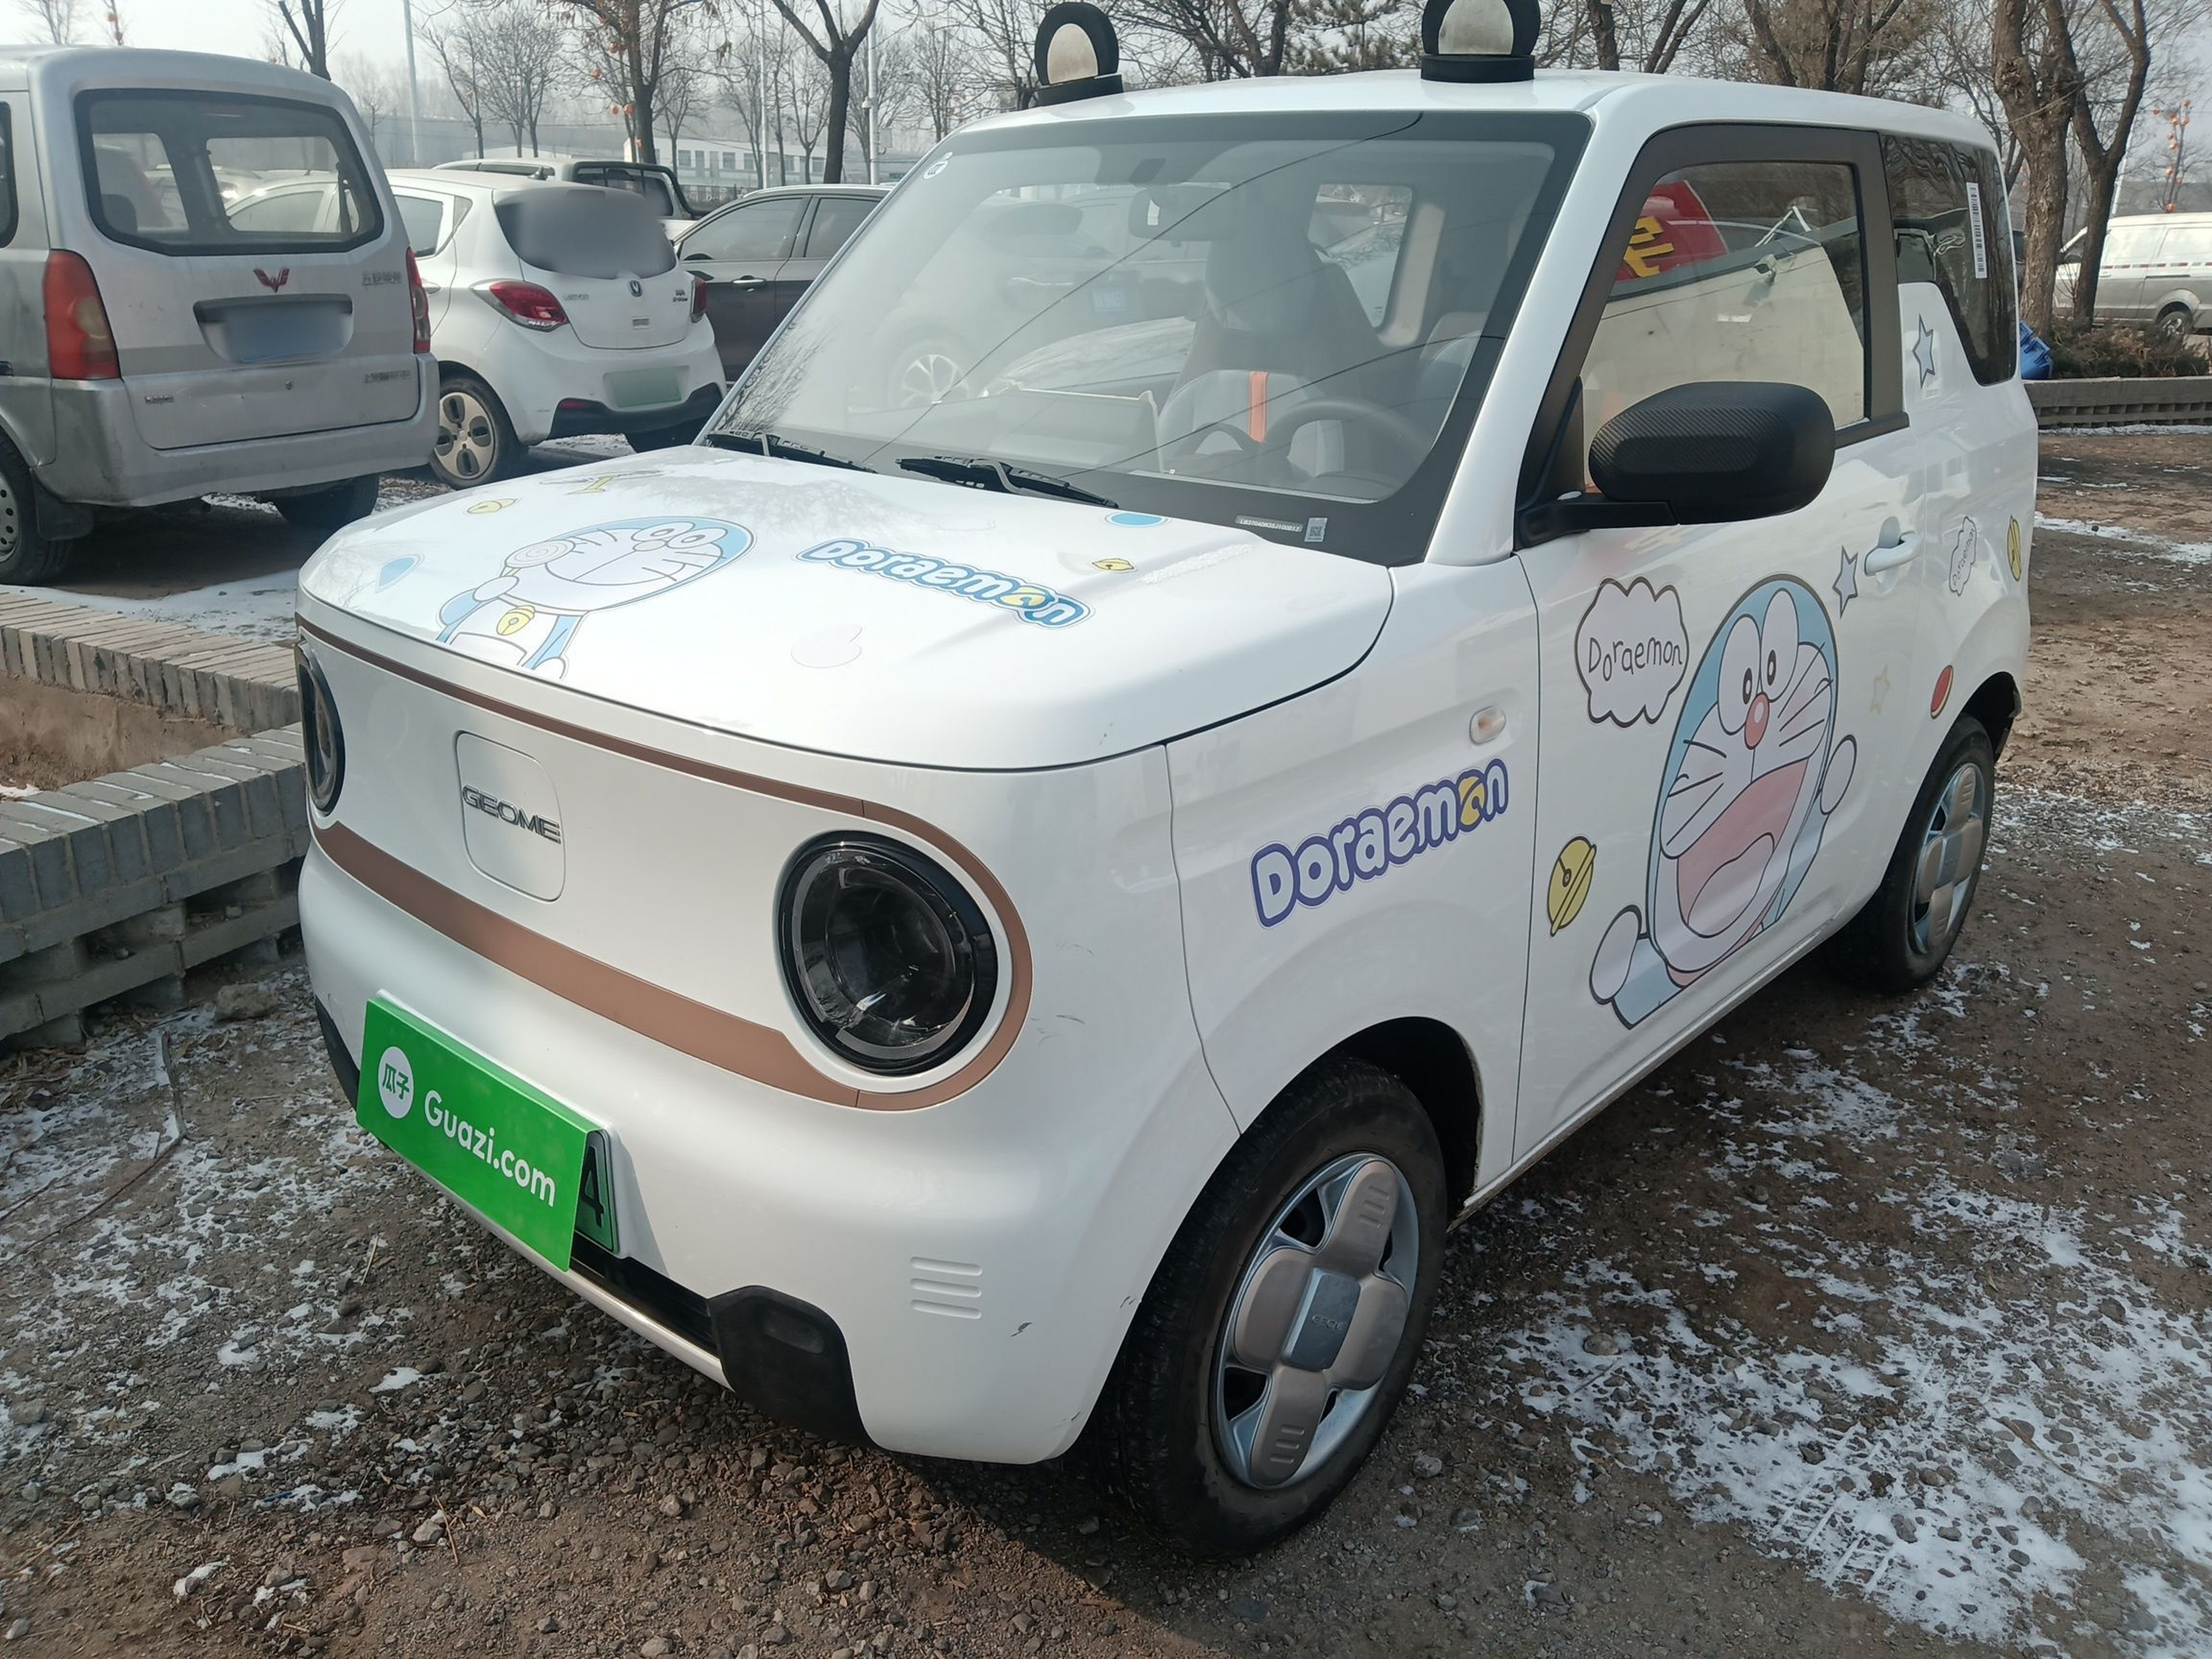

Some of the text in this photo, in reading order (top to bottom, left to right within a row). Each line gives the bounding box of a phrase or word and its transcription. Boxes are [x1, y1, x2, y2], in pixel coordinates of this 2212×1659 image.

[801, 539, 1085, 626] Doraemon
[1588, 637, 1683, 681] Doraemon
[462, 785, 562, 844] GEOME
[1251, 757, 1509, 928] Doraemon
[381, 1063, 411, 1100] 瓜子
[424, 1089, 556, 1207] Guazi.com
